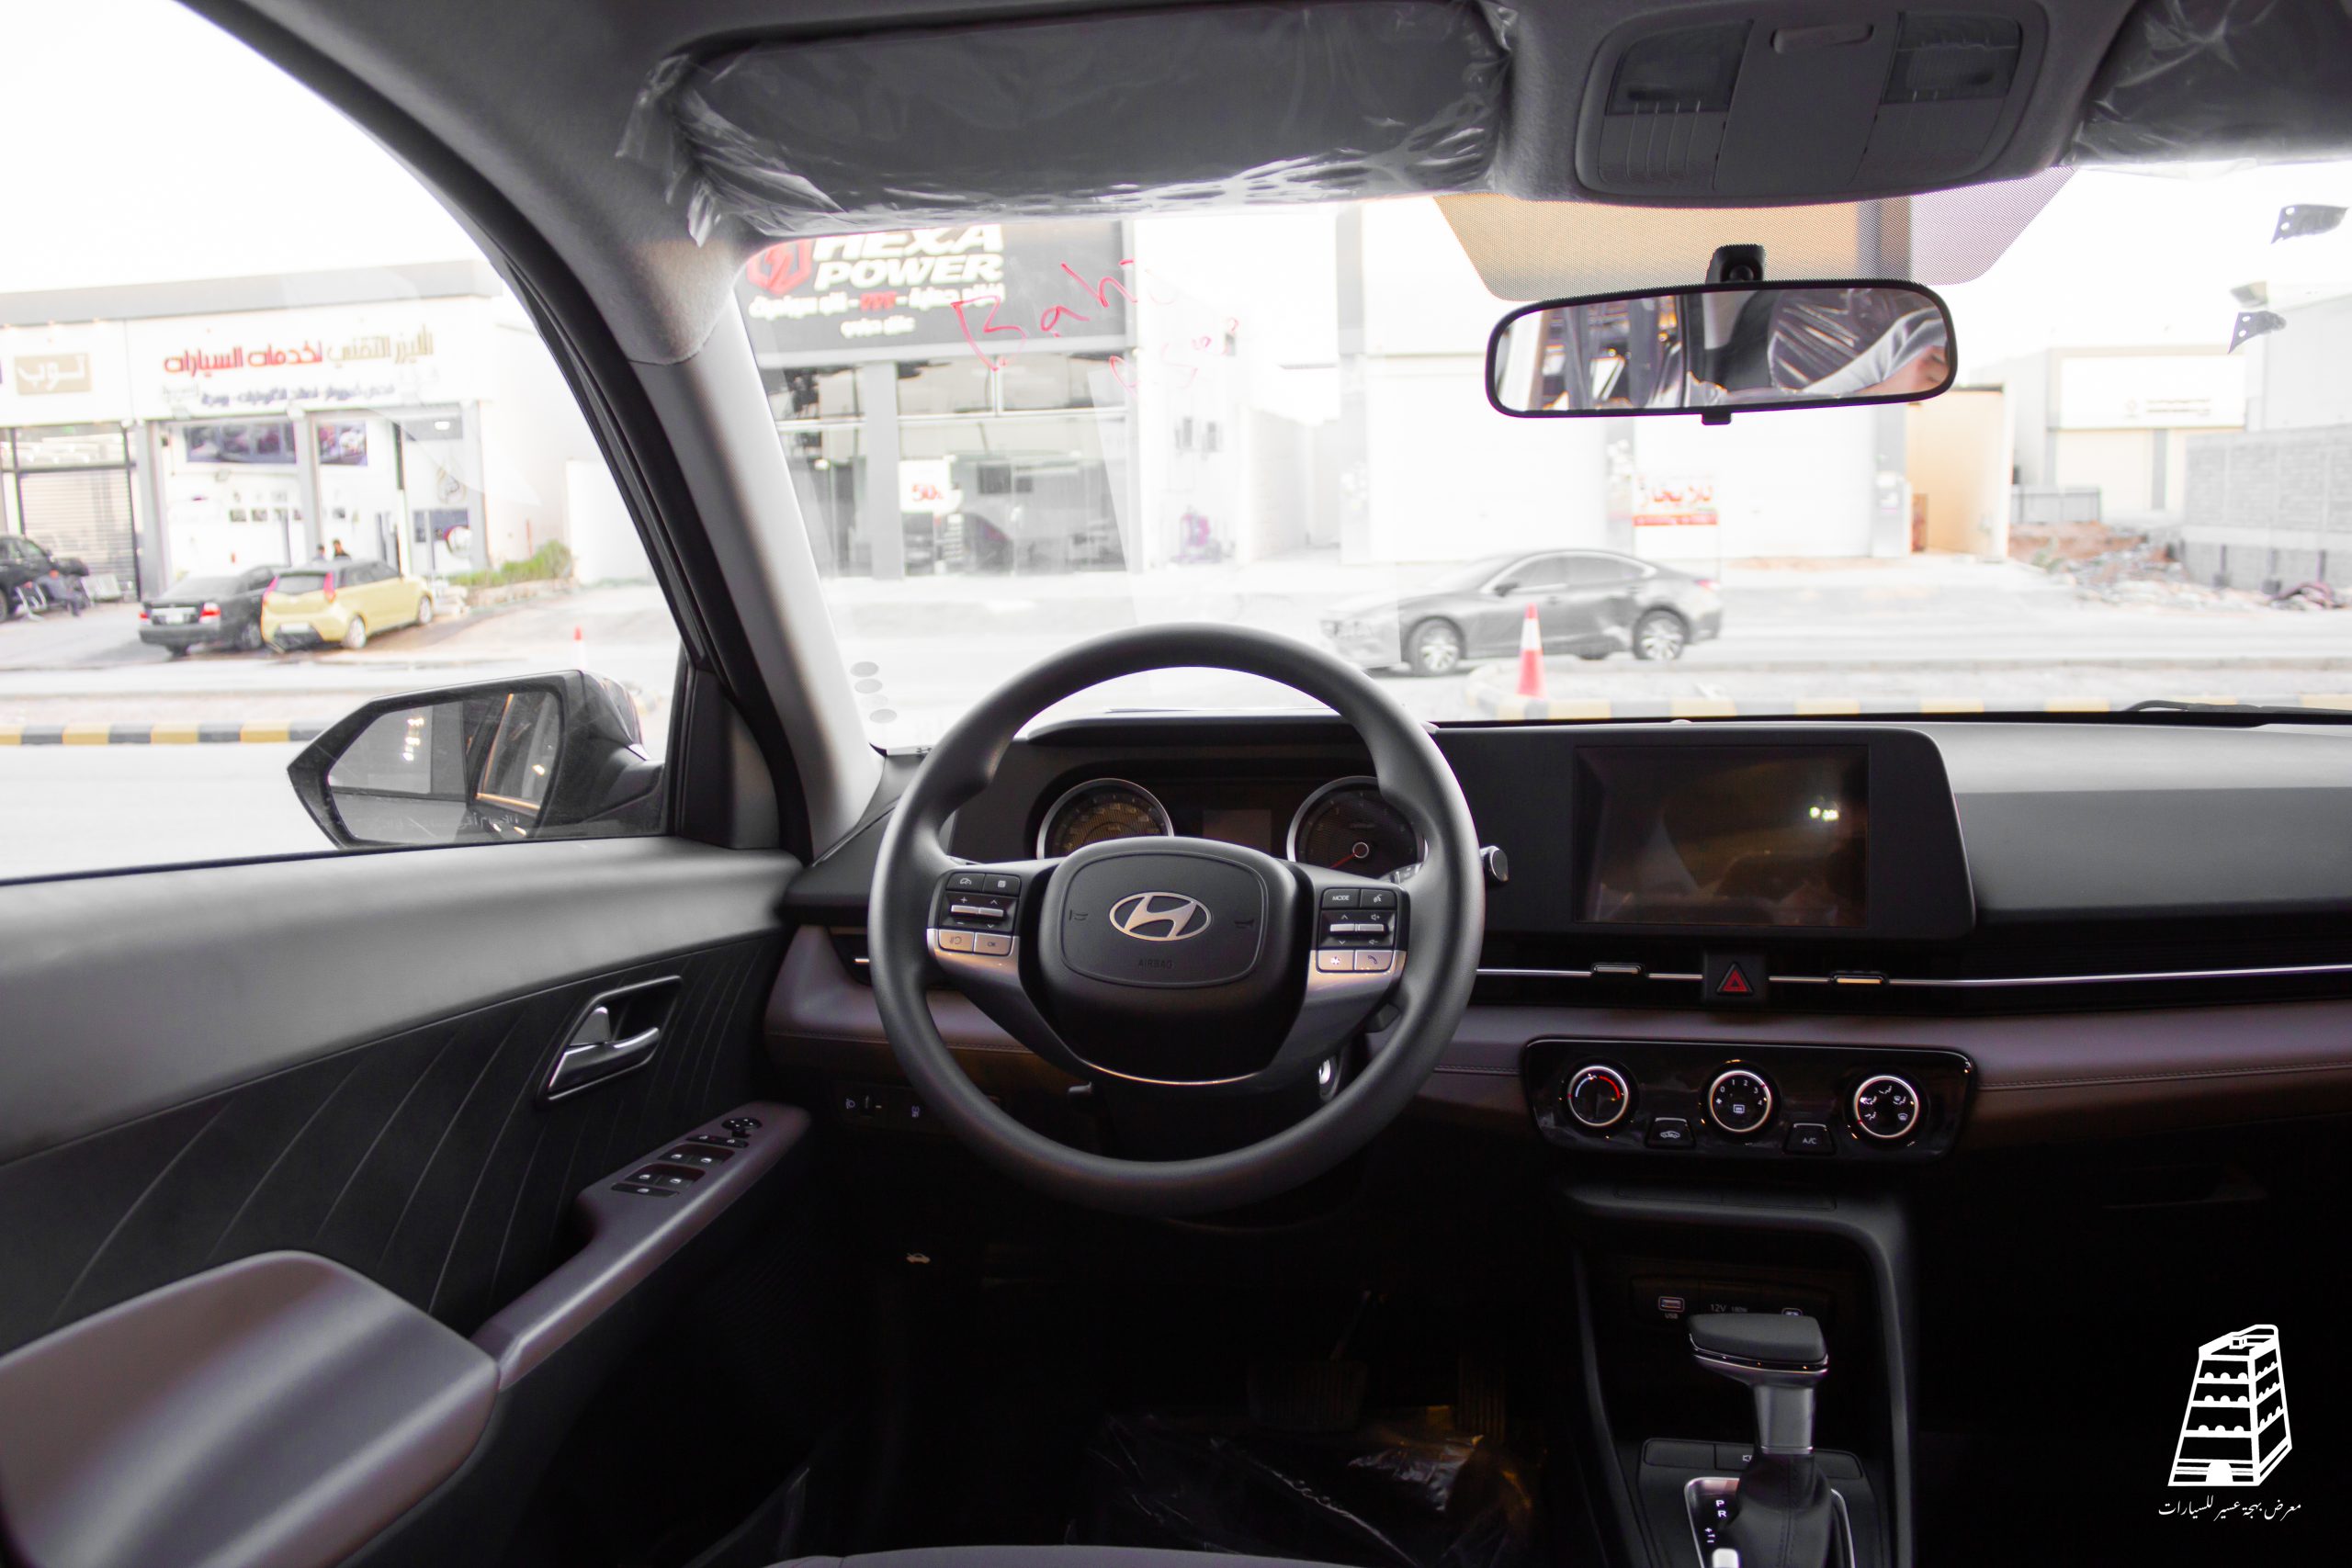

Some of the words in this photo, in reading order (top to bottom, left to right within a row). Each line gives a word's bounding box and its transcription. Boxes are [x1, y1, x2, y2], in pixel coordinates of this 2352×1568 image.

[814, 254, 1004, 291] POWER
[164, 345, 243, 378] السيارات
[1711, 1303, 1727, 1313] 12V
[1715, 1499, 1724, 1507] P
